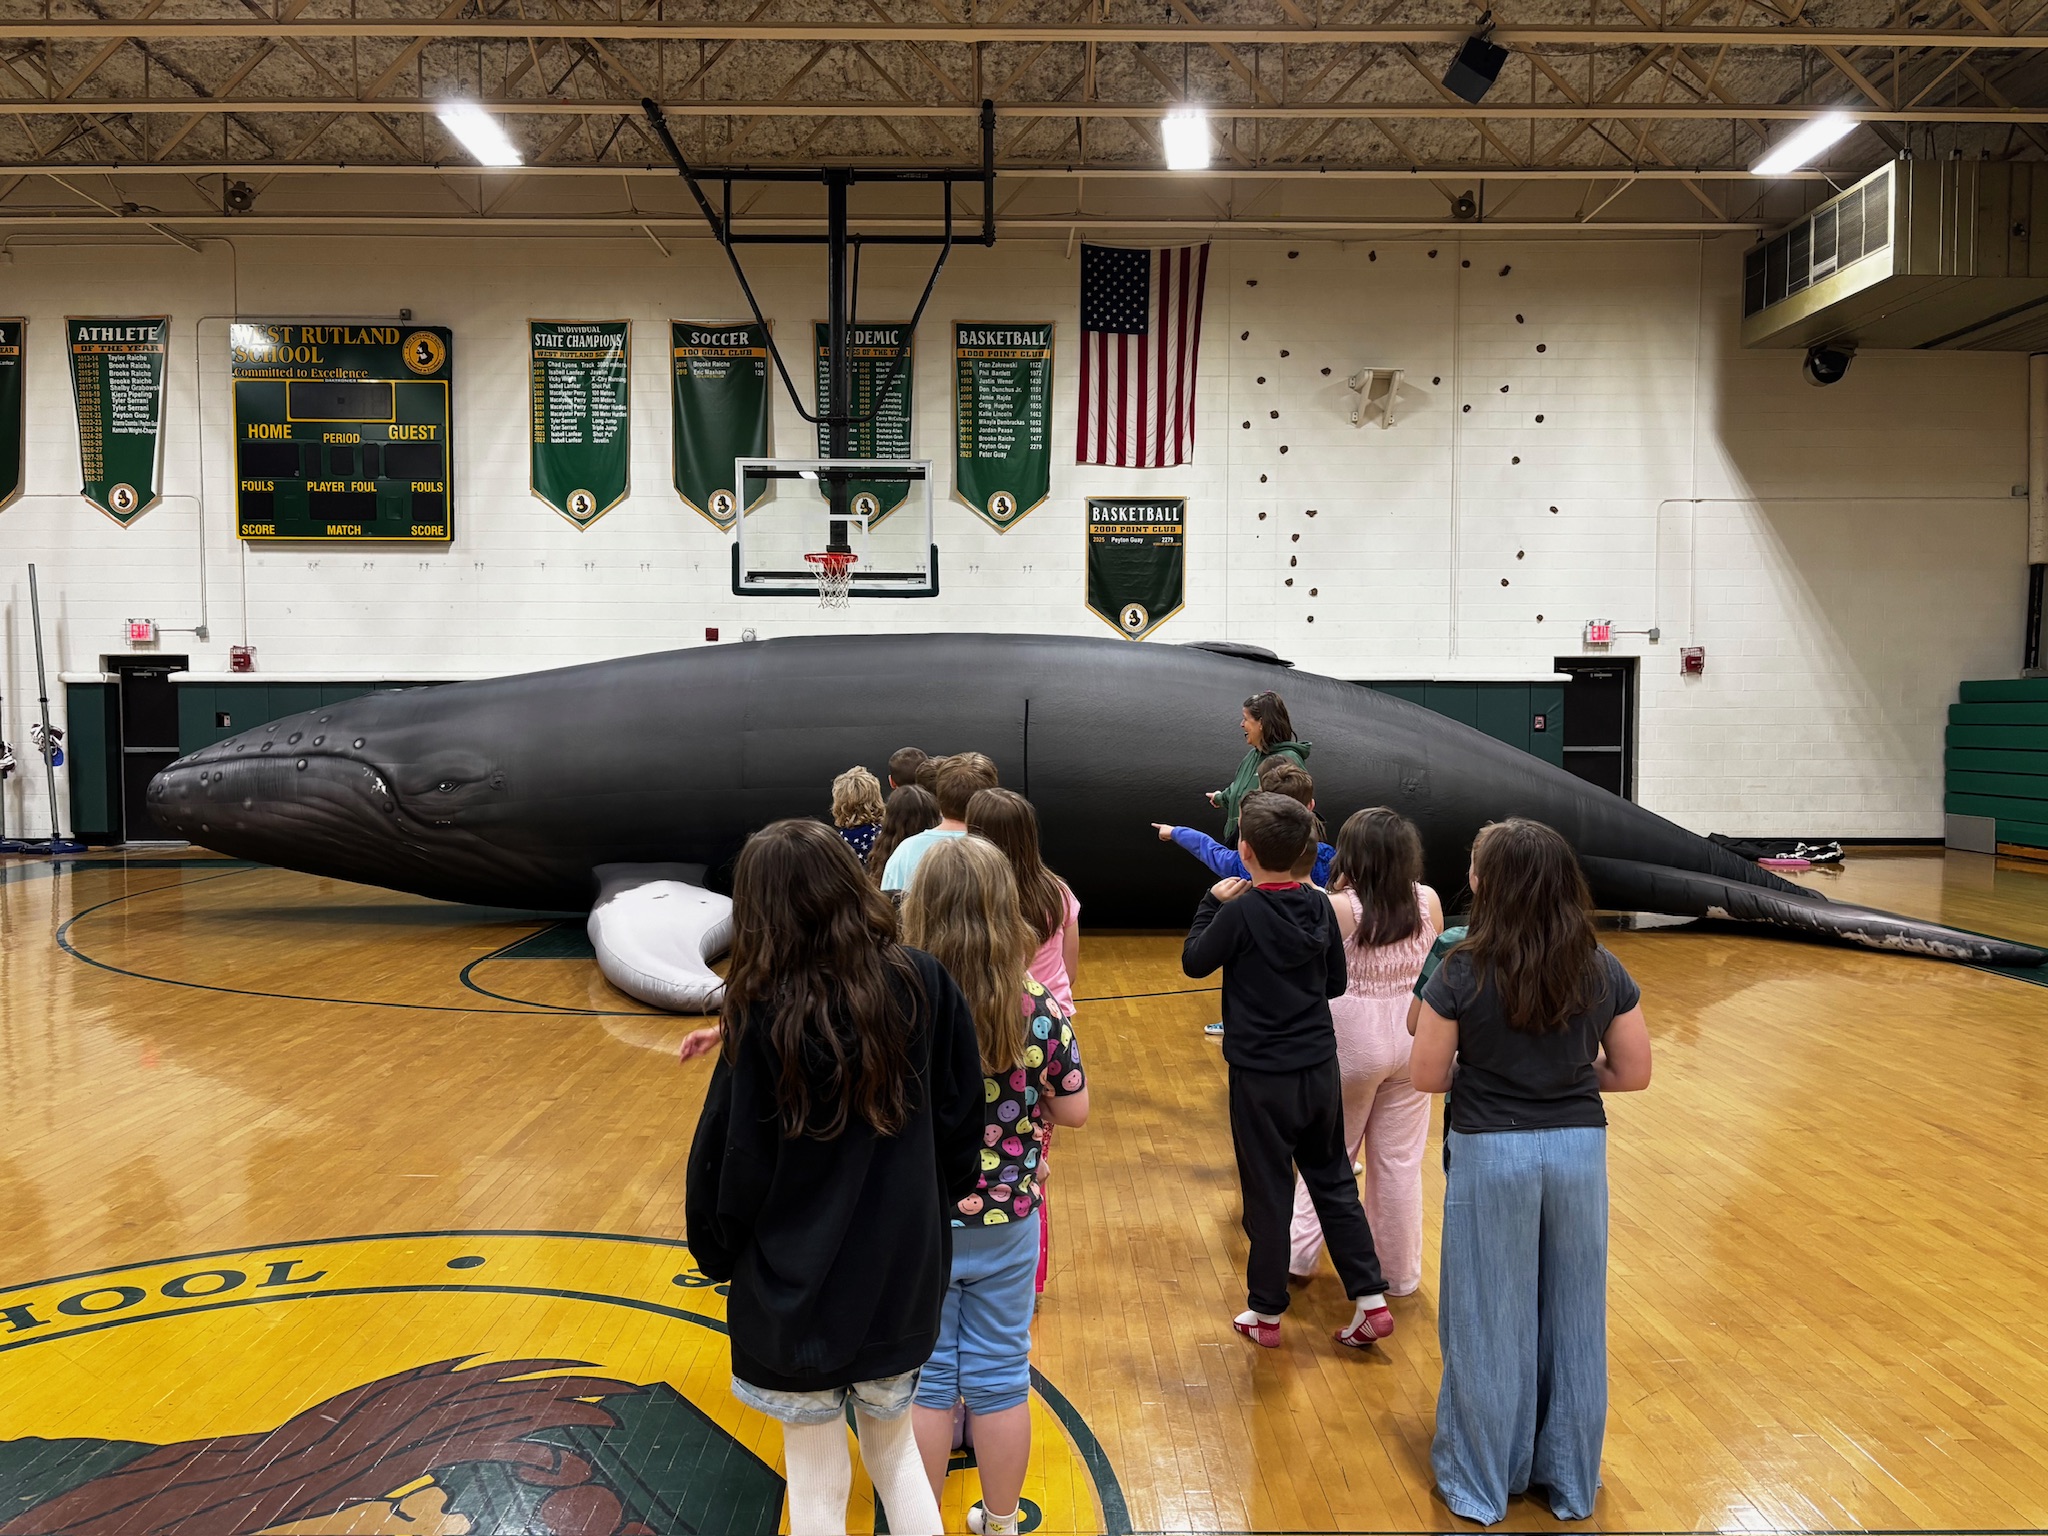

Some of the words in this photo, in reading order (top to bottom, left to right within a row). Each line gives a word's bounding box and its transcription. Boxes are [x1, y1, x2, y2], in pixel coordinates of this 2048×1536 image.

[78, 327, 158, 341] ATHLETE
[234, 326, 294, 344] WEST
[301, 327, 399, 345] RUTLAND
[535, 334, 563, 347] STATE
[567, 334, 621, 347] CHAMPIONS
[691, 332, 749, 345] SOCCER
[960, 331, 1046, 345] BASKETBALL
[0, 346, 14, 354] EAR
[234, 345, 324, 364] SCHOOL
[108, 354, 125, 362] Taylor
[234, 367, 292, 379] Committed
[297, 368, 308, 378] to
[311, 368, 368, 379] Excellence
[248, 424, 292, 439] HOME
[388, 425, 436, 440] GUEST
[323, 433, 360, 444] PERIOD
[993, 451, 1007, 459] Guay
[241, 481, 274, 491] FOULS
[307, 482, 345, 492] PLAYER
[351, 482, 377, 492] FOUL
[411, 482, 443, 492] FOULS
[1092, 507, 1179, 521] BASKETBALL
[242, 525, 275, 535] SCORE
[327, 525, 361, 535] MATCH
[411, 525, 444, 536] SCORE
[131, 624, 150, 639] EXIT
[1591, 626, 1610, 640] EXIT
[0, 1260, 329, 1334] HOOL
